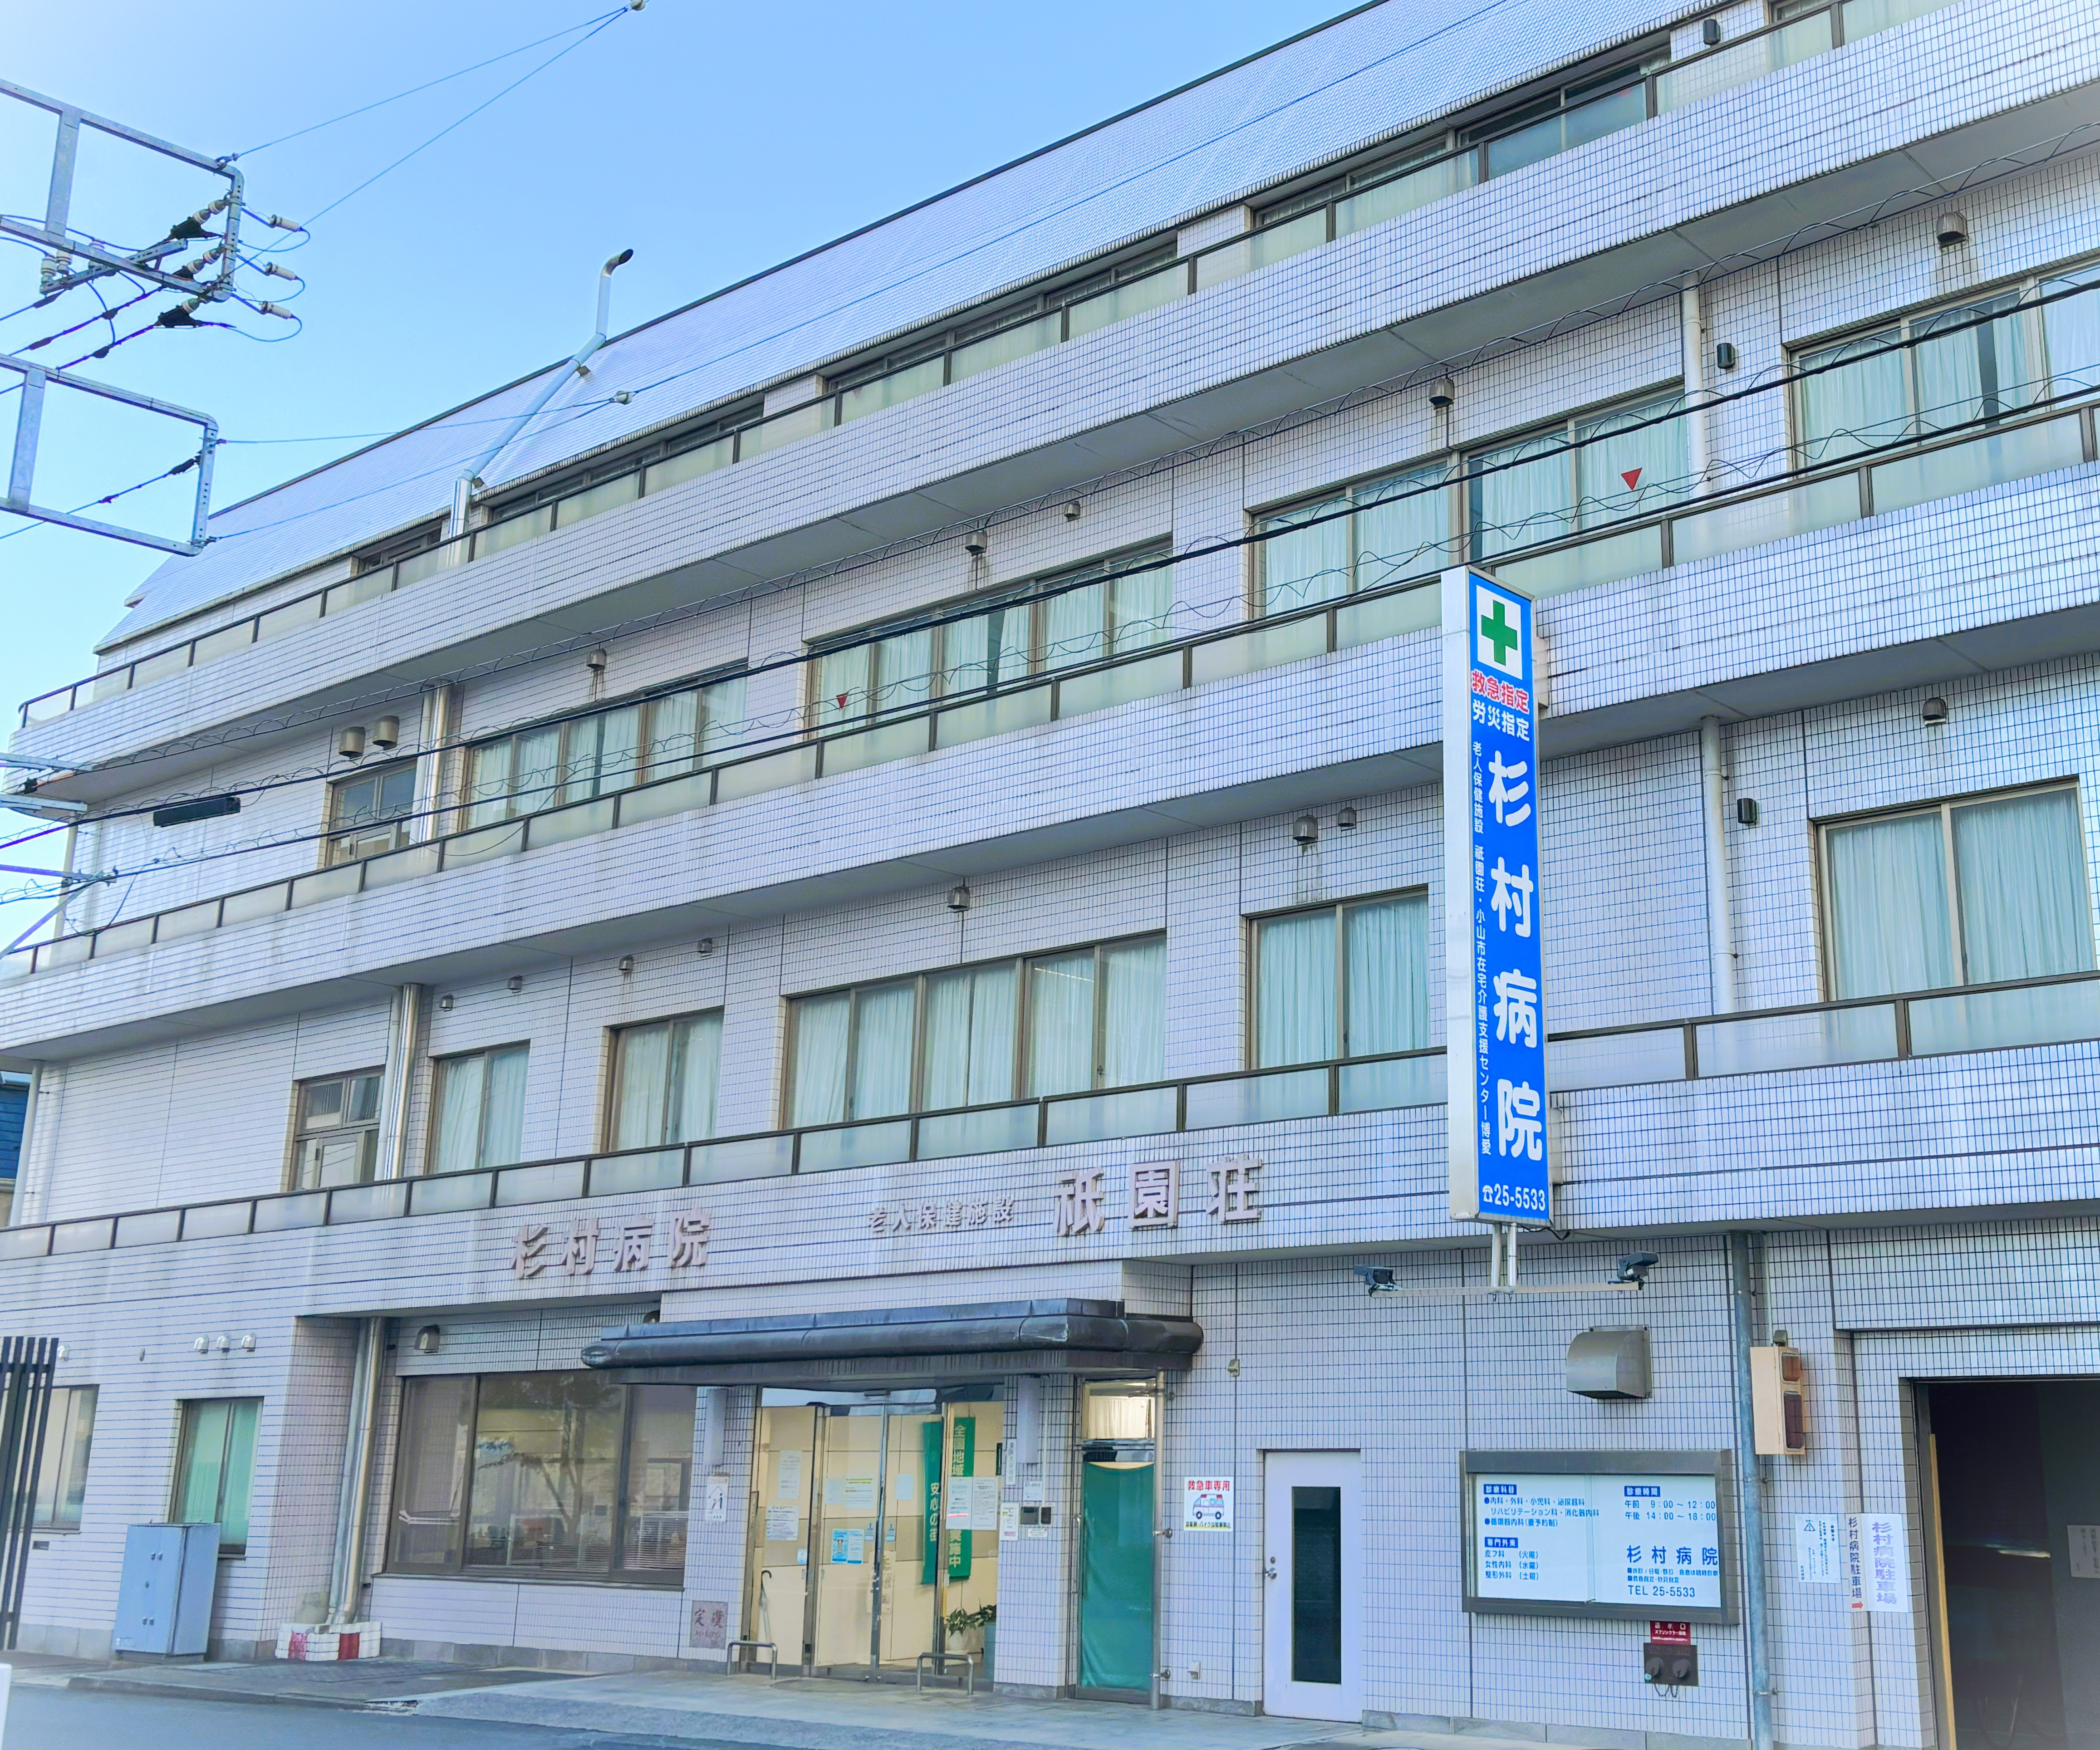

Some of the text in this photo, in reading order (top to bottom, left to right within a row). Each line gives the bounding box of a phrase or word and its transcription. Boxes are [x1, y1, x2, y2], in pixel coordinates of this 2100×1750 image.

[1472, 669, 1529, 715] 救急指定
[1472, 699, 1530, 741] 労災指定
[1472, 741, 1484, 834] 老人保健施設
[1488, 750, 1542, 1161] 杉村病院
[870, 1154, 1264, 1237] 老人保健施設 祇園荘
[1494, 1183, 1546, 1211] 25-5533
[510, 1207, 712, 1279] 杉村病院
[1188, 1480, 1230, 1491] 救急車専用
[1625, 1512, 1640, 1520] 午後
[1627, 1545, 1718, 1565] 杉村病院
[1848, 1517, 1862, 1598] 杉村病院駐車場
[1872, 1522, 1897, 1604] 杉村病院駐車場
[1628, 1585, 1695, 1597] TEL 25-5533
